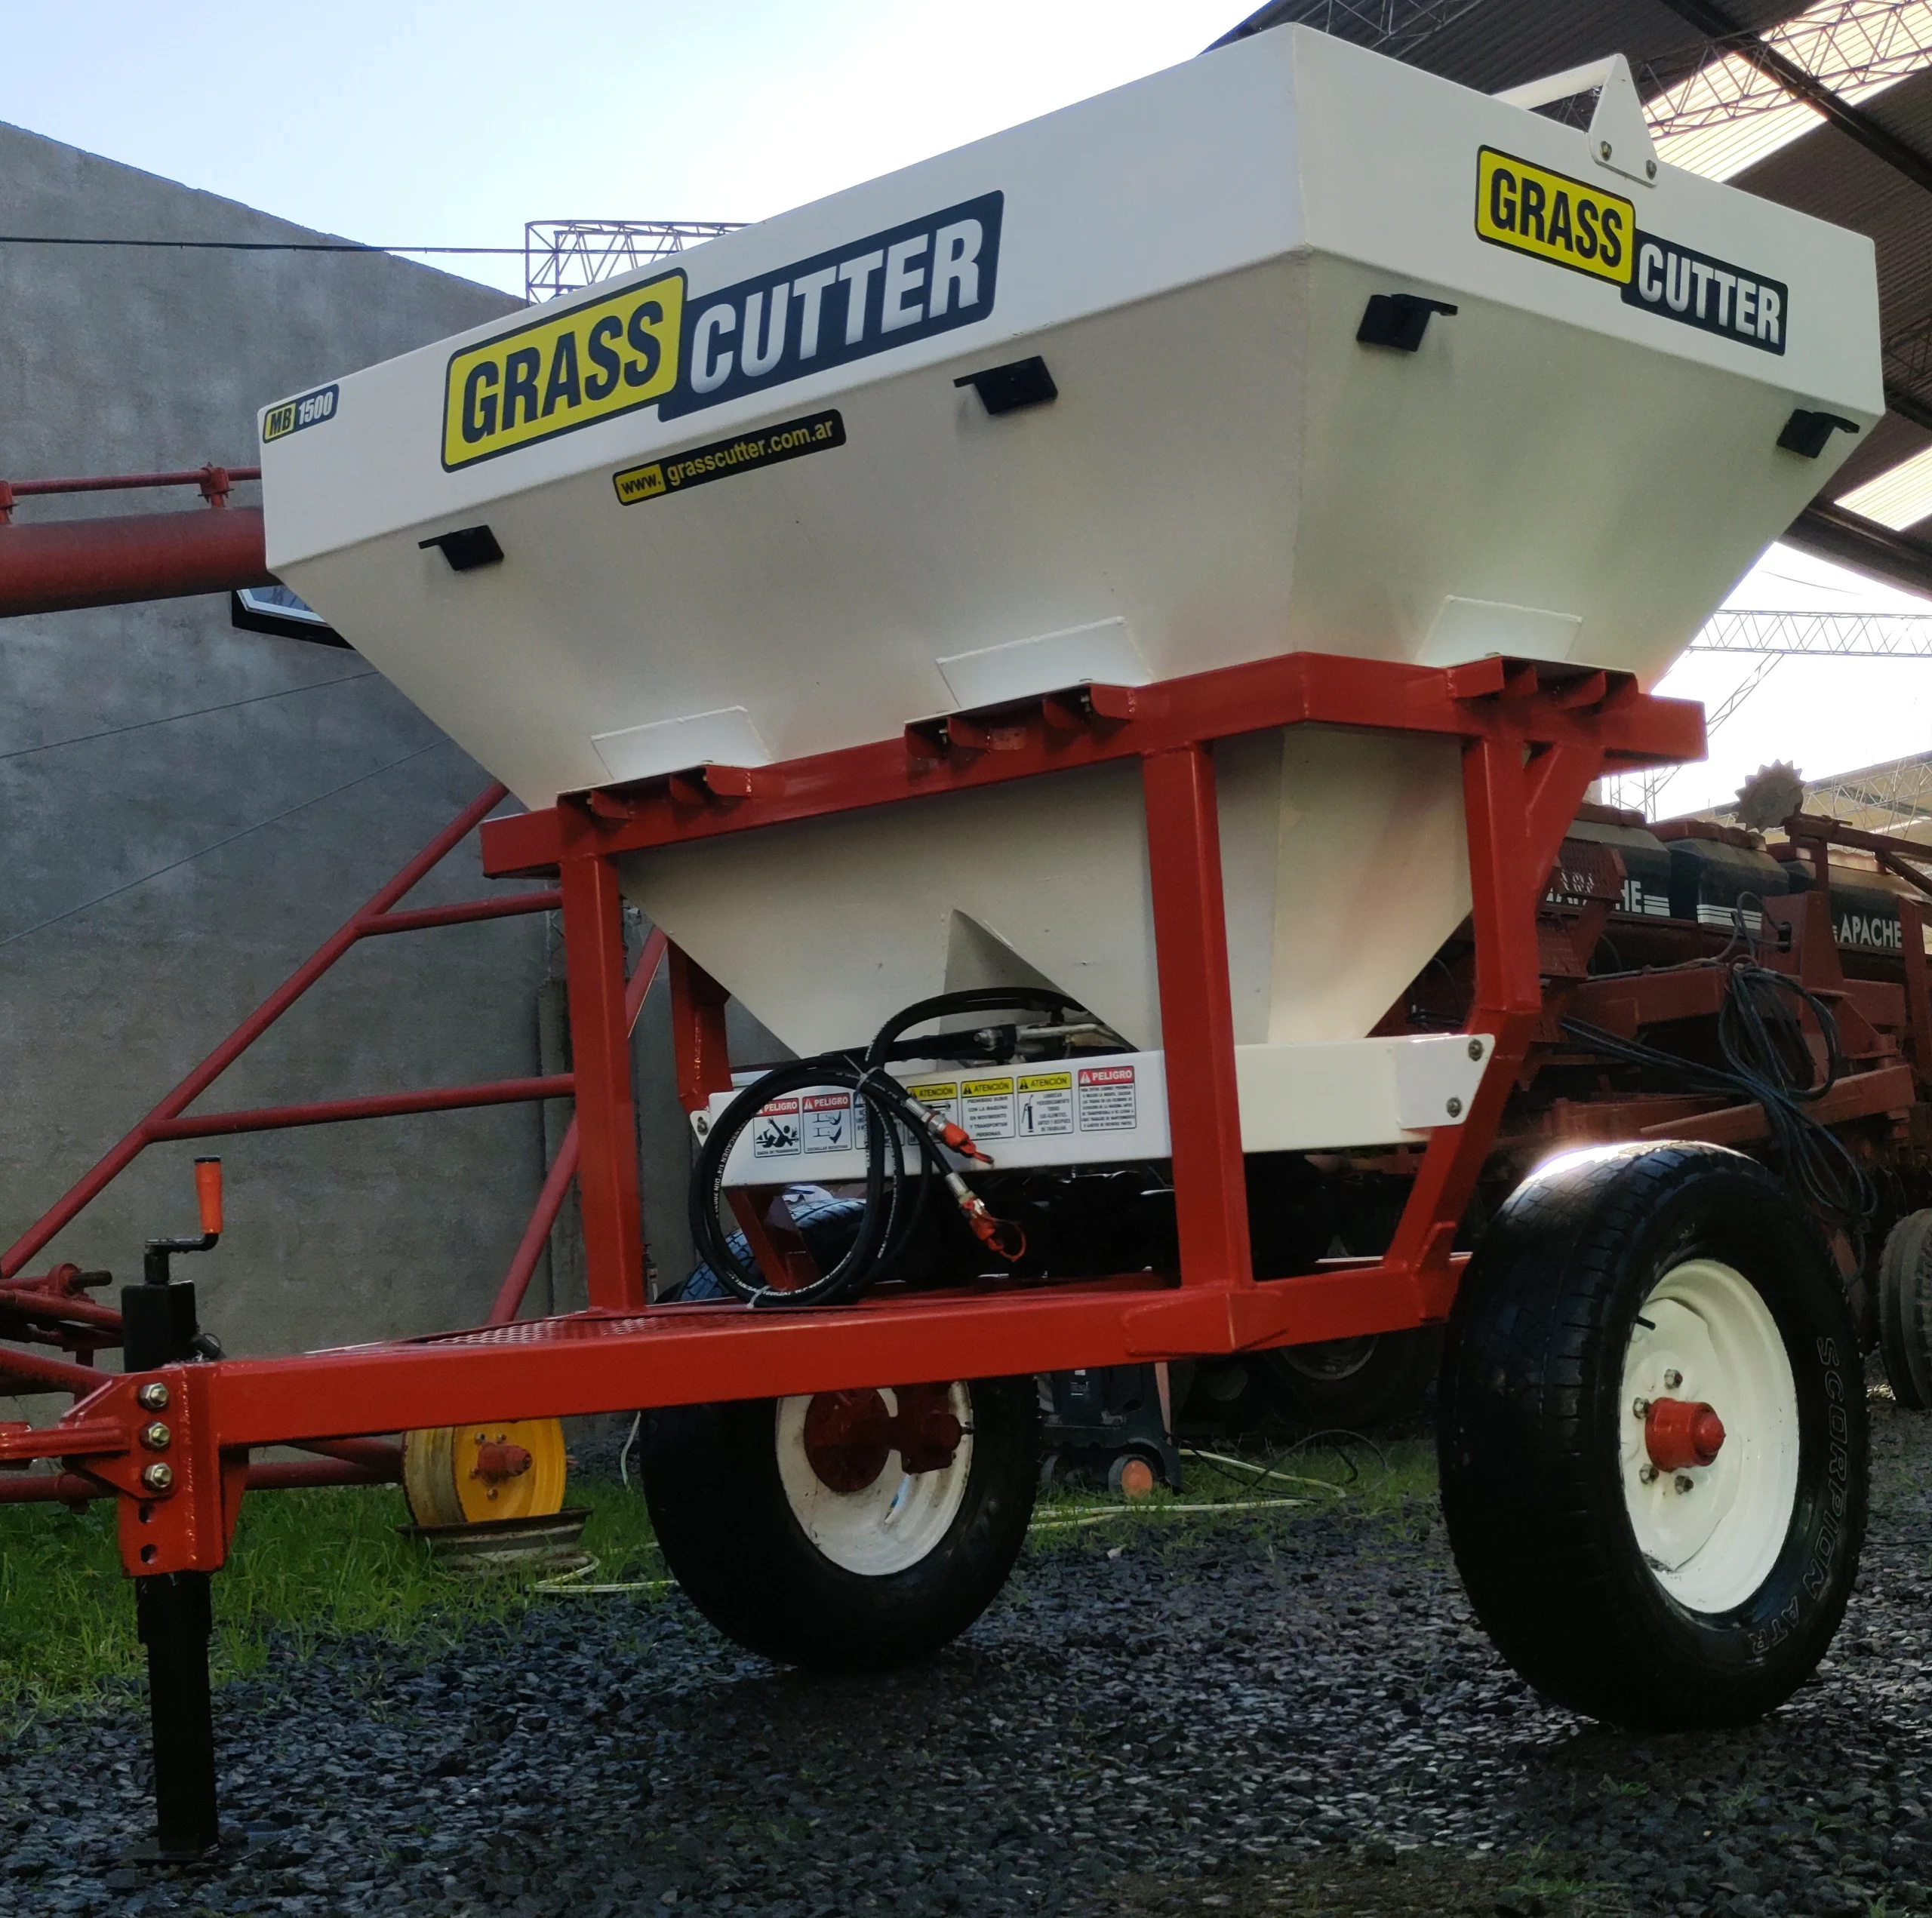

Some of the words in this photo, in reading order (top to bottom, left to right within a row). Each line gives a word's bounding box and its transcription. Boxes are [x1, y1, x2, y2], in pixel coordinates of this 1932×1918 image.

[1490, 168, 1622, 268] GRASS
[1638, 243, 1780, 344] CUTTER
[461, 300, 662, 446] GRASS
[690, 217, 983, 392] CUTTER
[269, 407, 292, 436] MB
[299, 391, 334, 425] 1500
[621, 472, 661, 495] www.
[666, 420, 833, 487] grasscutter.com.ar
[1840, 913, 1902, 948] APACHE
[918, 1087, 953, 1097] ATENCIÓN
[974, 1082, 1009, 1093] ATENCIÓN
[1030, 1077, 1067, 1087] ATENCIÓN
[1093, 1070, 1132, 1080] PELIGRO
[764, 1102, 797, 1112] PELIGRO
[814, 1096, 848, 1107] PELIGRO
[1802, 1336, 1848, 1601] SCORPION
[1748, 1596, 1801, 1655] ATR
